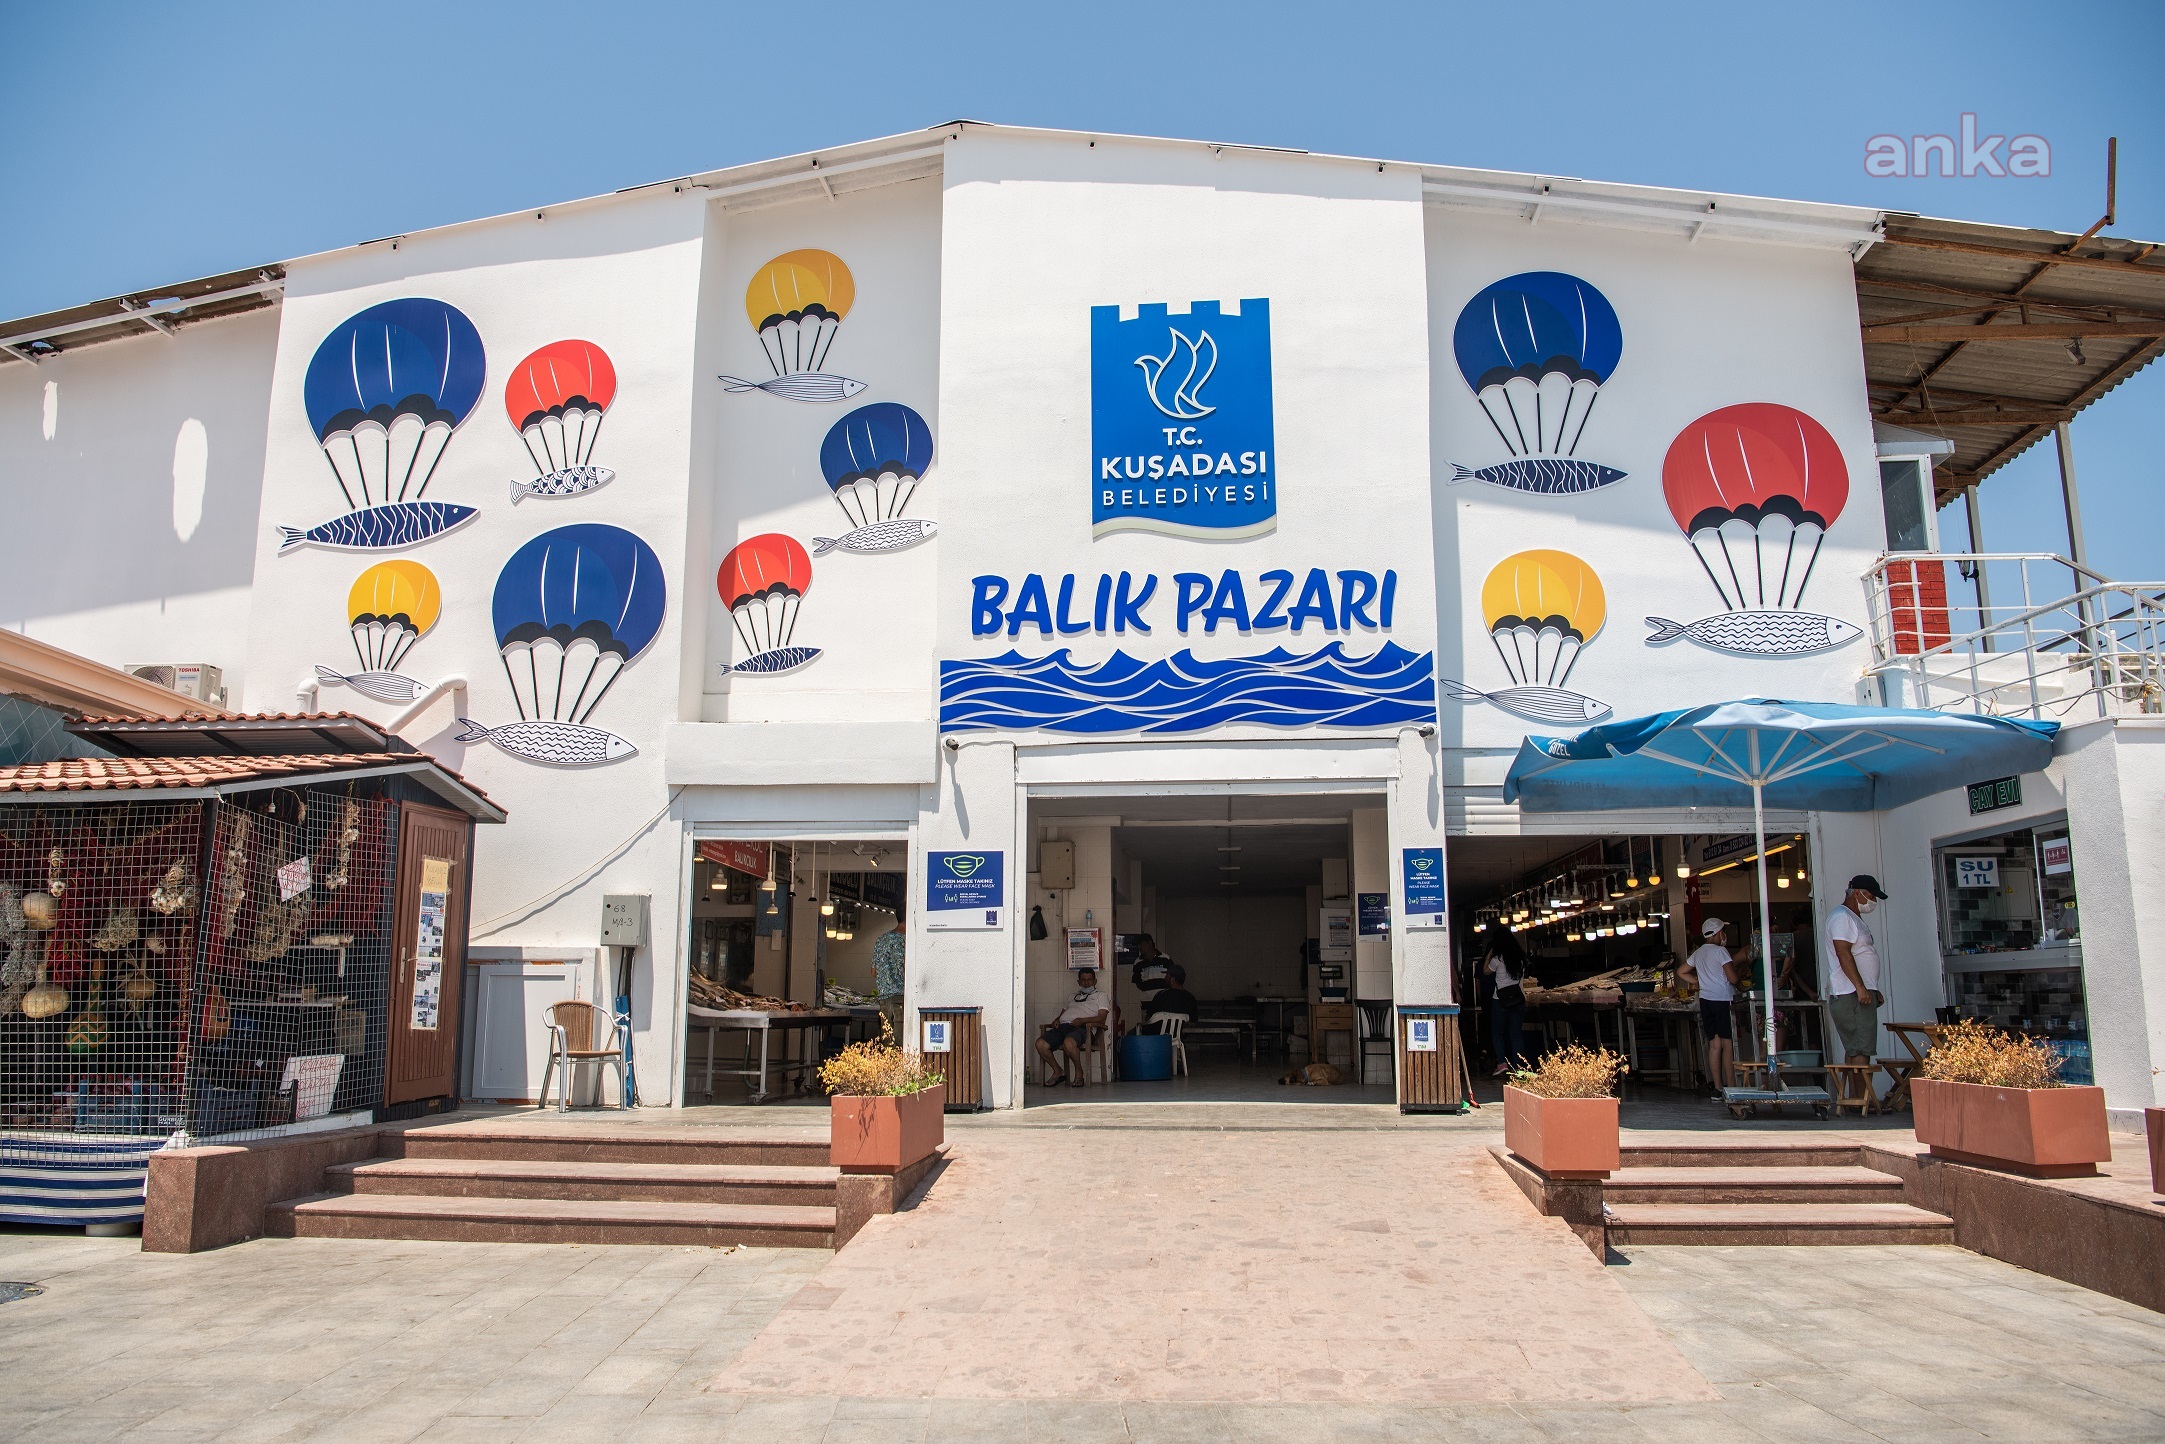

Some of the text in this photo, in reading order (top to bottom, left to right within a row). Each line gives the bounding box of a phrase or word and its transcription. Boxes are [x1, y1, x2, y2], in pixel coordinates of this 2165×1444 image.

[1163, 426, 1203, 446] T.C.
[1101, 451, 1267, 480] KUŞADASI
[1102, 481, 1268, 506] BELEDİYESİ
[971, 568, 1397, 636] BALIK PAZARI
[1969, 776, 2019, 814] ÇAY EVİ
[1960, 861, 1993, 872] SU
[1963, 873, 1991, 885] 1 TL
[613, 904, 626, 913] 68
